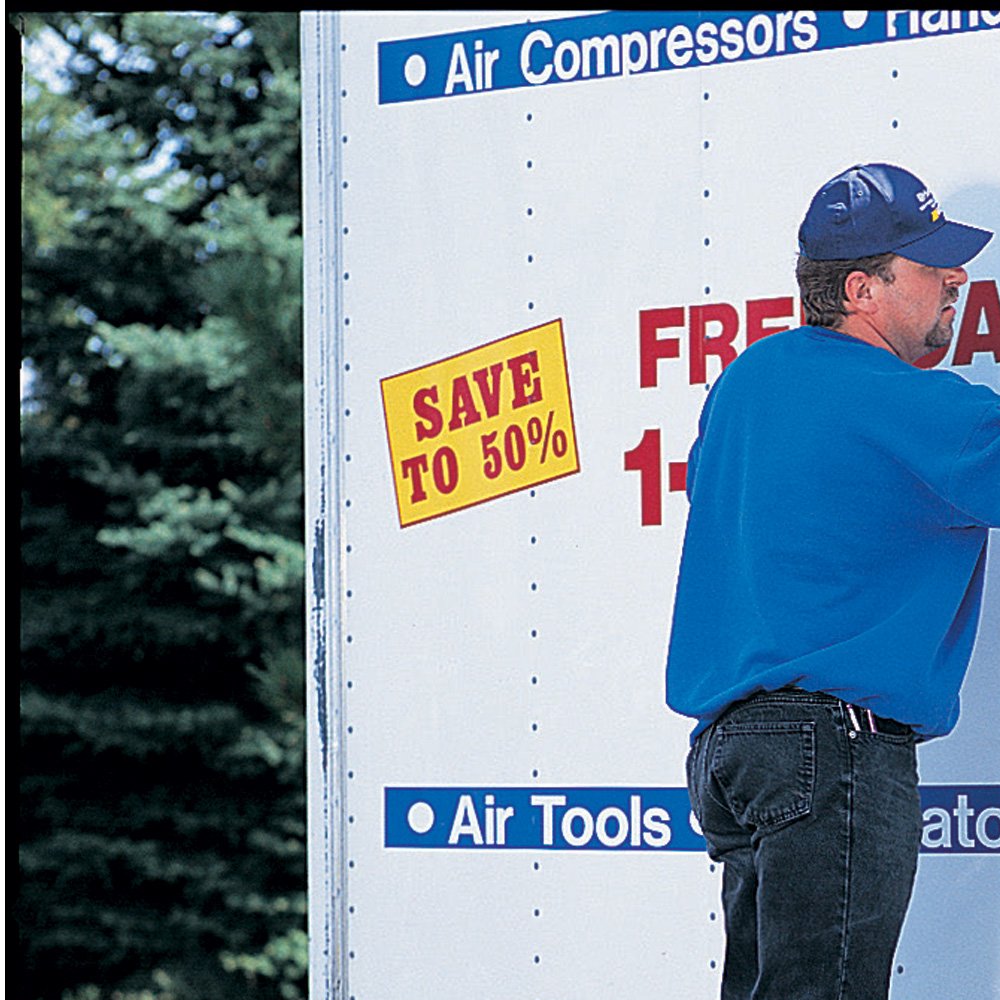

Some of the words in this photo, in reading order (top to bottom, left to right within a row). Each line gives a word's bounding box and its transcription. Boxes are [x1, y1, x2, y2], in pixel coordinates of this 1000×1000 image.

[444, 40, 499, 95] Air
[520, 10, 819, 79] Compressors
[639, 296, 804, 388] FR
[412, 349, 543, 442] SAVE
[400, 445, 459, 504] TO
[480, 410, 568, 480] 50%
[448, 794, 514, 845] Air
[531, 795, 672, 847] Tools
